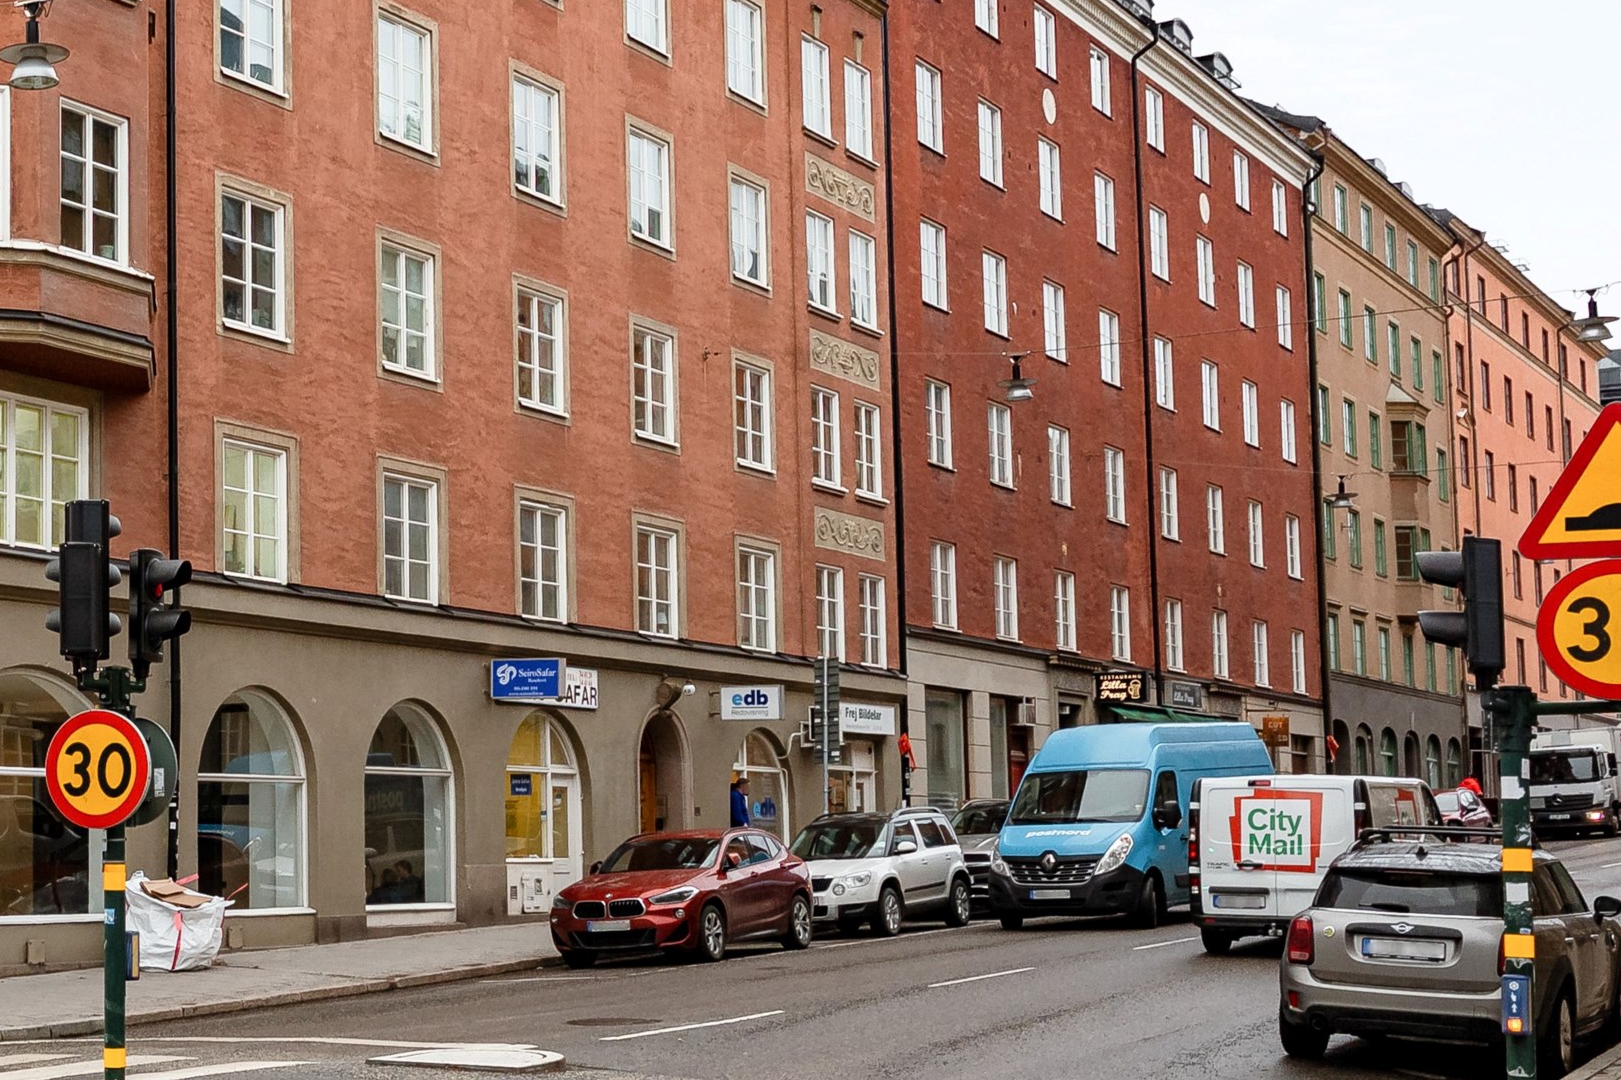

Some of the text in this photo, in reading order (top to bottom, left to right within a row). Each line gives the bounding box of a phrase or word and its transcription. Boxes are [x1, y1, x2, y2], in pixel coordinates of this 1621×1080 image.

[1566, 596, 1611, 663] 3
[1100, 680, 1127, 690] Lilla
[556, 684, 597, 706] AFAR
[732, 689, 768, 706] edb
[1100, 690, 1127, 700] Prag
[845, 707, 882, 722] Frej Bildelar
[63, 742, 132, 798] 30
[1248, 808, 1303, 836] City
[1025, 829, 1092, 838] postnord
[1249, 833, 1303, 855] Mail
